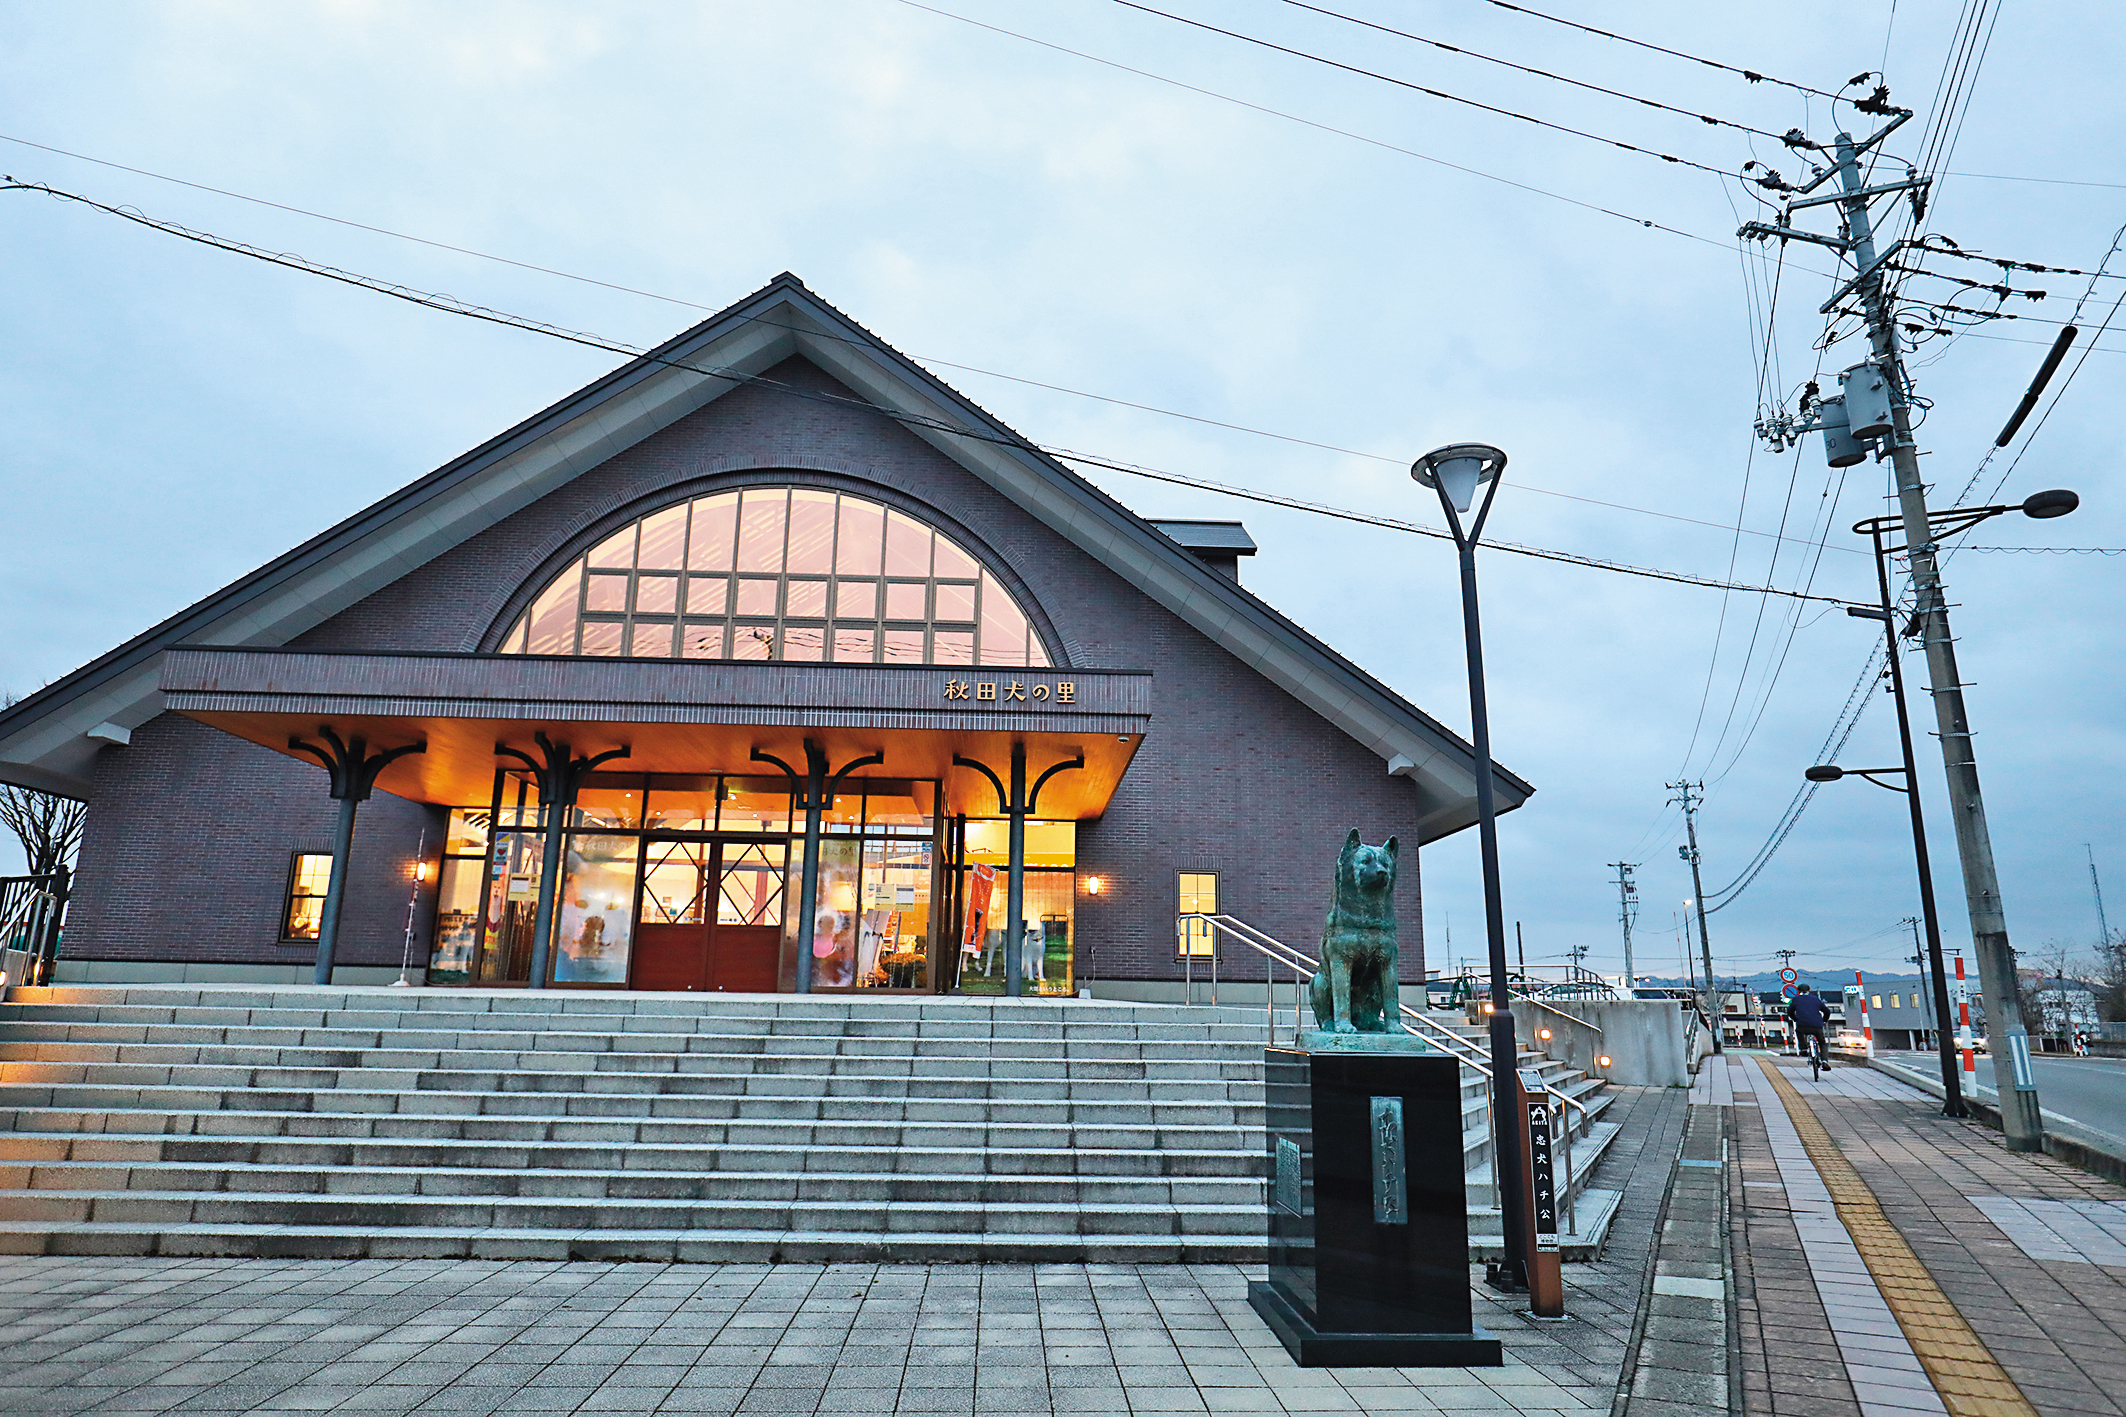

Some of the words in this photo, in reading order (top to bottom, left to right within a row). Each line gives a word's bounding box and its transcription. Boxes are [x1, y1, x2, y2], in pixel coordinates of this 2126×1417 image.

[944, 679, 1076, 704] 秋田犬の里
[1536, 1134, 1550, 1219] 忠犬ハチ公
